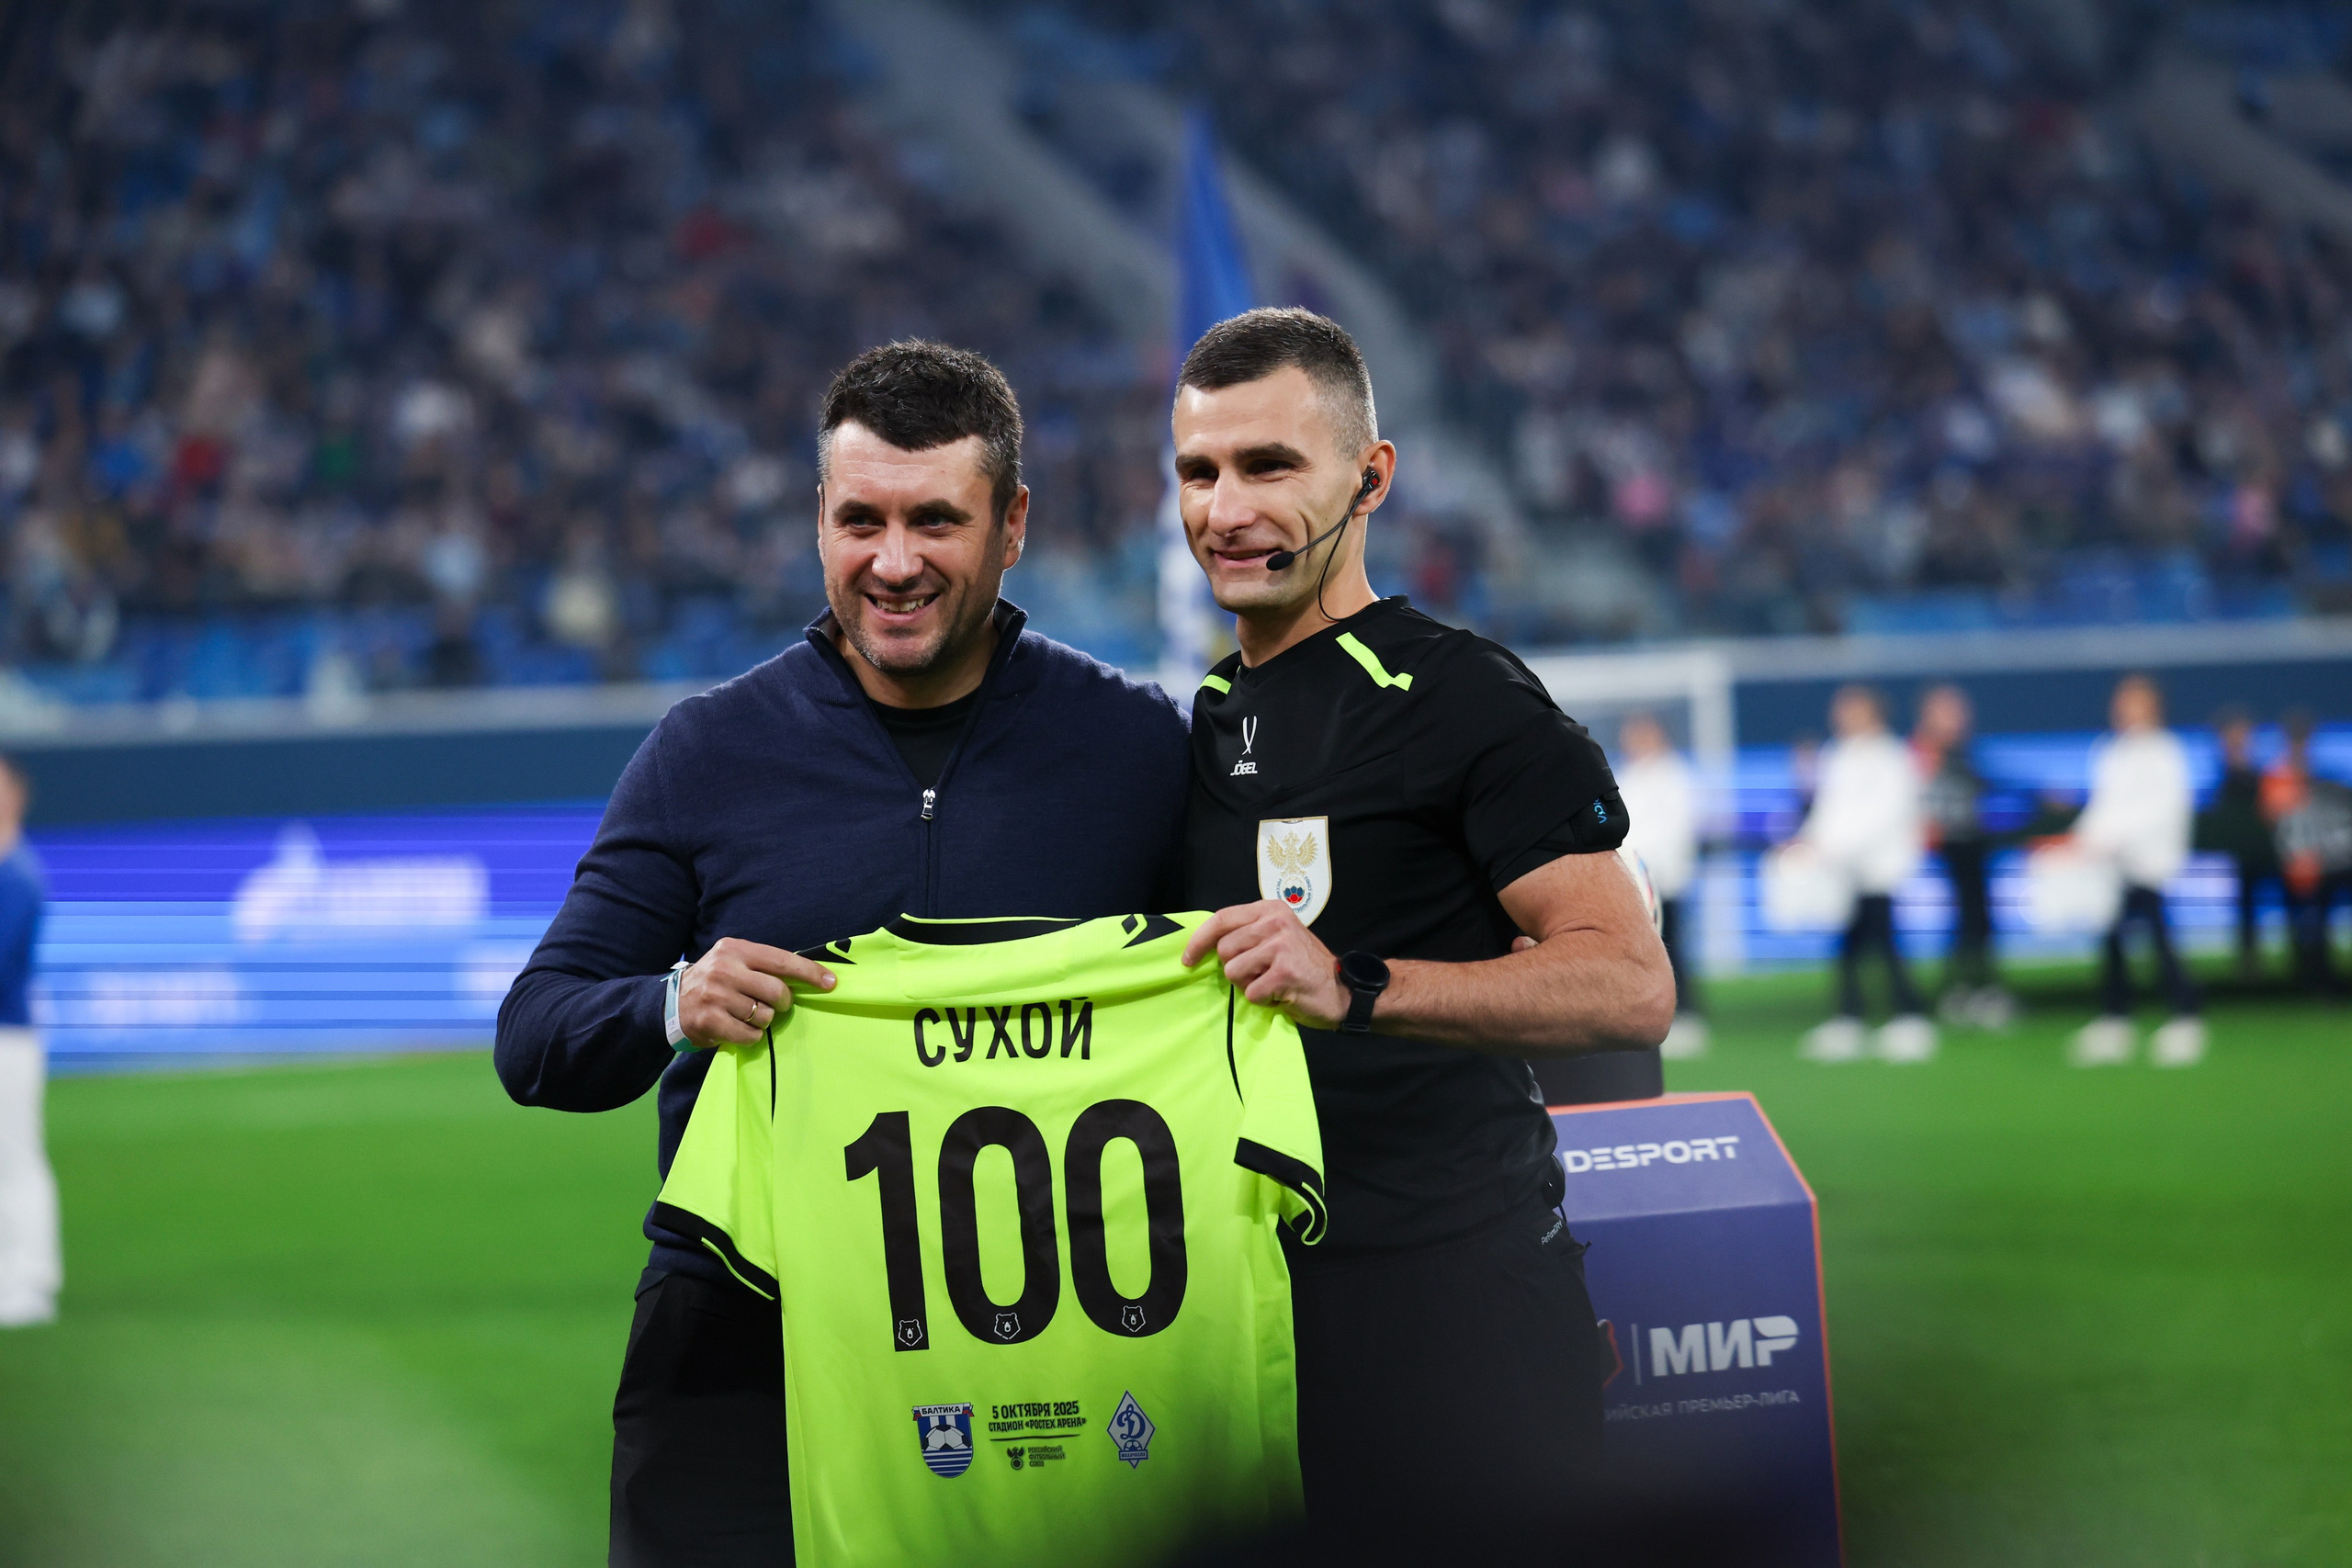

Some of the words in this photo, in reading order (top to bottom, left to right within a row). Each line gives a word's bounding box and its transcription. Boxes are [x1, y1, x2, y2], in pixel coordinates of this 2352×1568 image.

[1230, 760, 1258, 776] JÖGEL
[913, 997, 1093, 1067] СУХОЙ
[1563, 1135, 1740, 1173] DESPORT
[843, 1099, 1188, 1352] 100
[1649, 1314, 1799, 1377] МИР
[922, 1405, 961, 1416] БАЛТИКА
[992, 1405, 999, 1419] 5
[1001, 1403, 1051, 1419] ОКТЯБРЯ
[1053, 1400, 1079, 1416] 2025
[1603, 1402, 1673, 1423] ИЙСКАЯ
[1678, 1389, 1801, 1415] ПРЕМЬЕР-ЛИГА
[989, 1420, 1023, 1432] СТАДИОН
